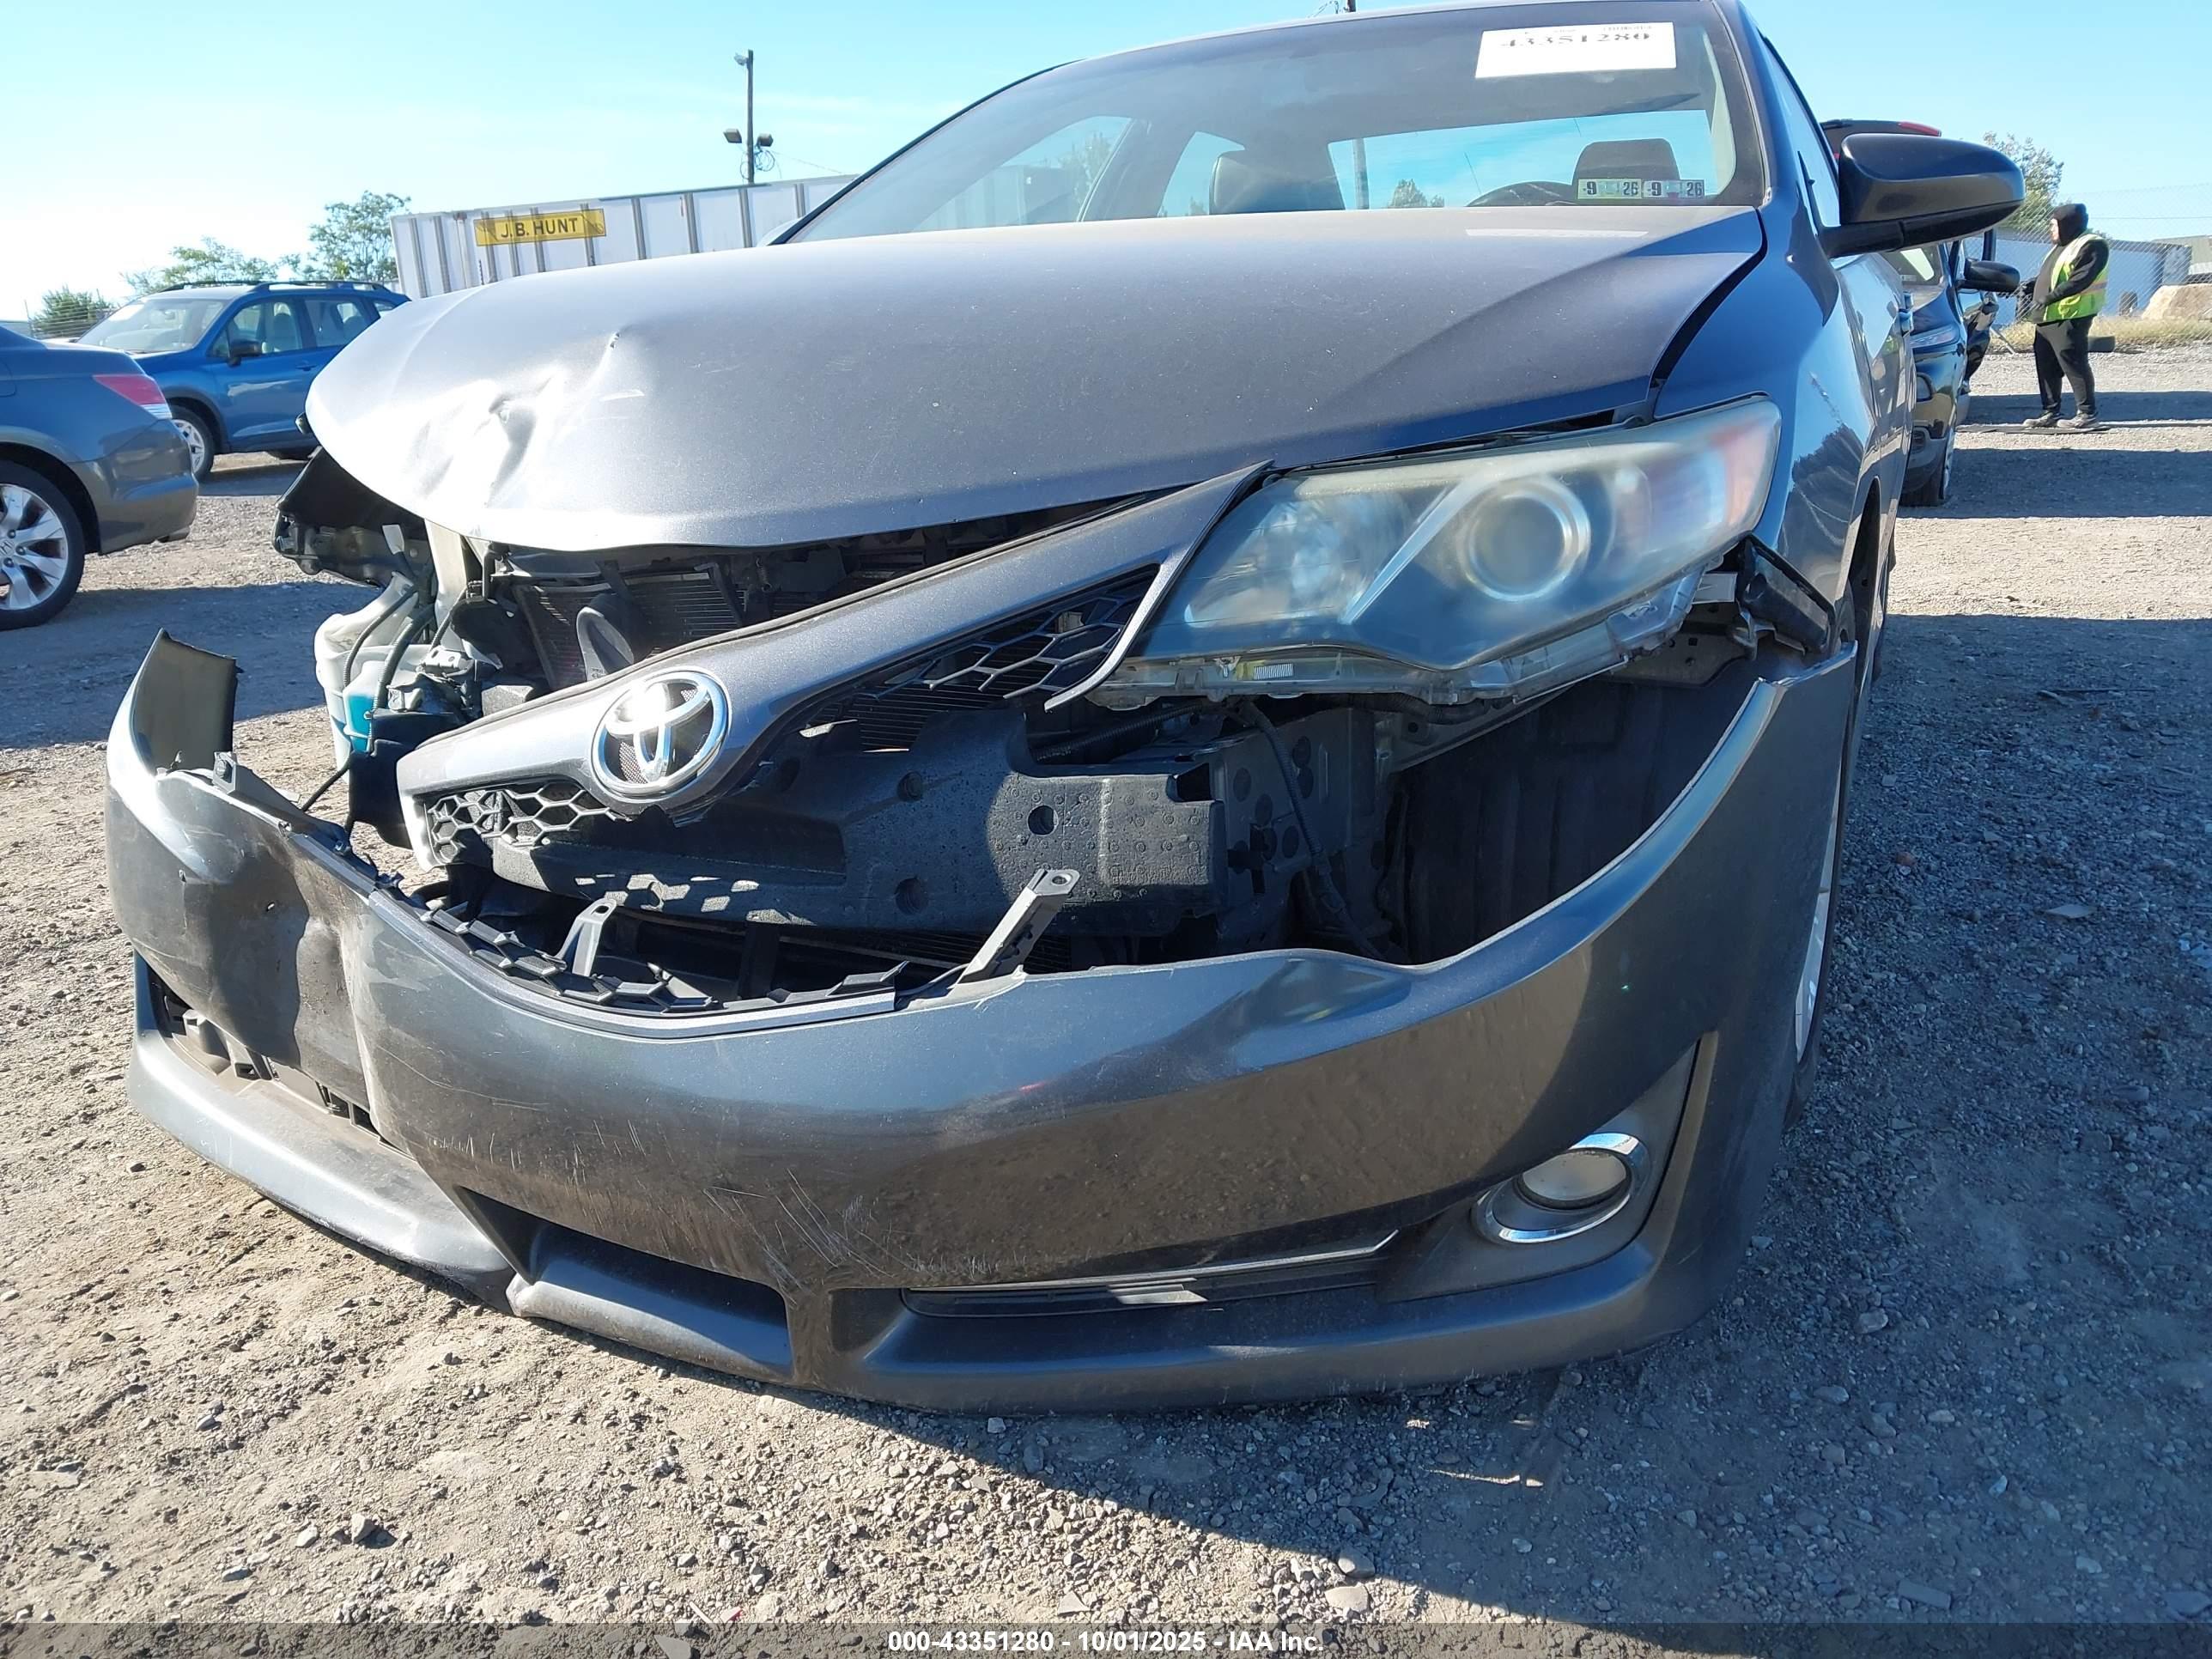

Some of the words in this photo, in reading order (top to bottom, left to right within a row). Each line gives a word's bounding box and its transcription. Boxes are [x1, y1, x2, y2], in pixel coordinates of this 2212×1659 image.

[1623, 181, 1638, 196] 26
[1686, 181, 1703, 197] 26
[532, 217, 578, 236] HUNT
